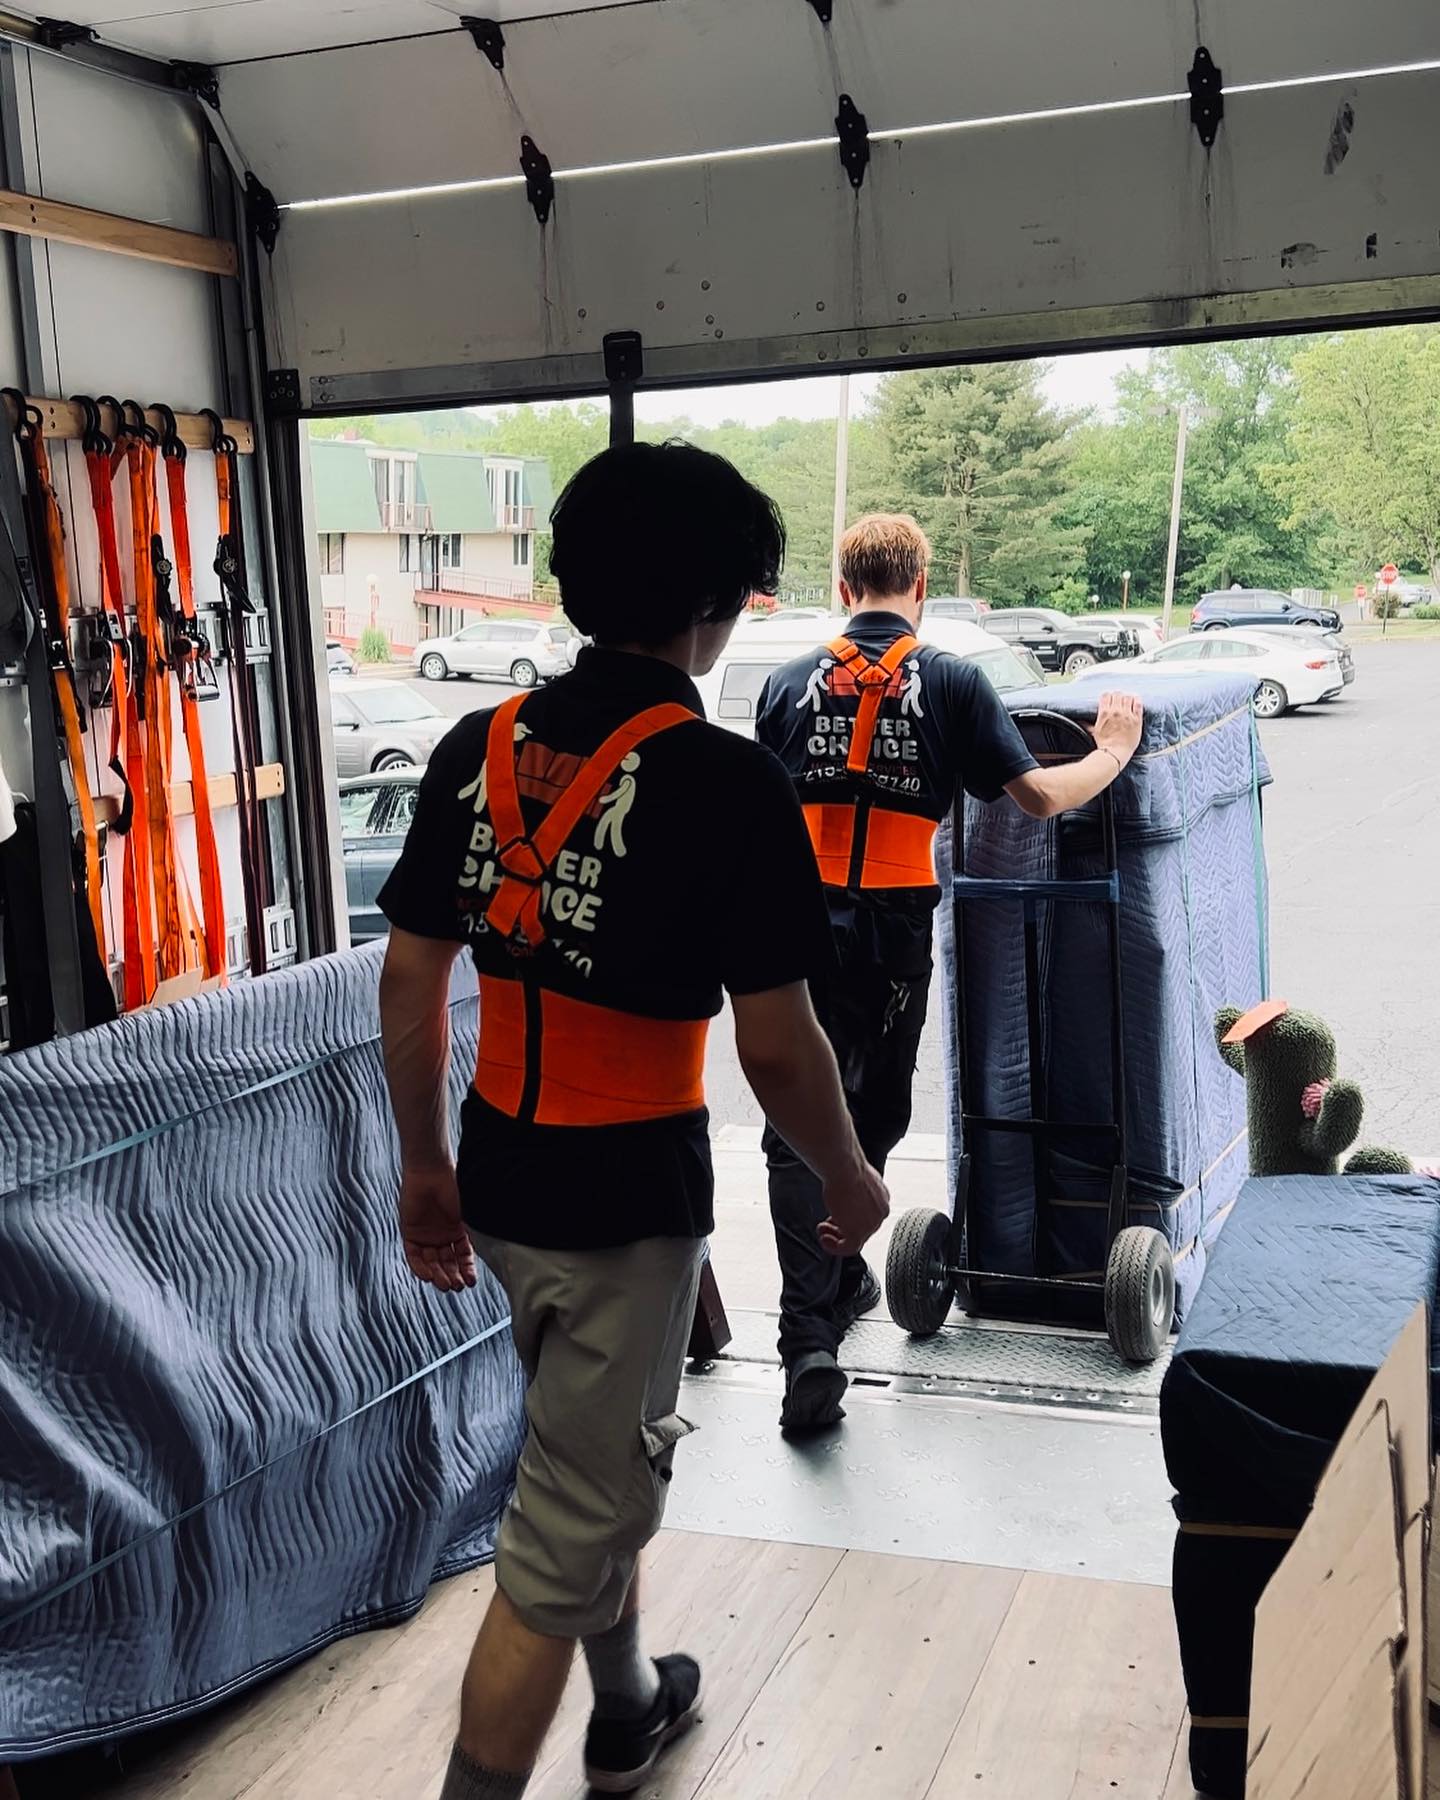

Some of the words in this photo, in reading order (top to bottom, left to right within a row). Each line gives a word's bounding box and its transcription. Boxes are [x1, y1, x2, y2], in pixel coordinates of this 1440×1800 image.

[807, 735, 918, 761] CHICE
[815, 715, 911, 737] BEER
[469, 820, 603, 889] BER
[457, 854, 604, 933] CHICE
